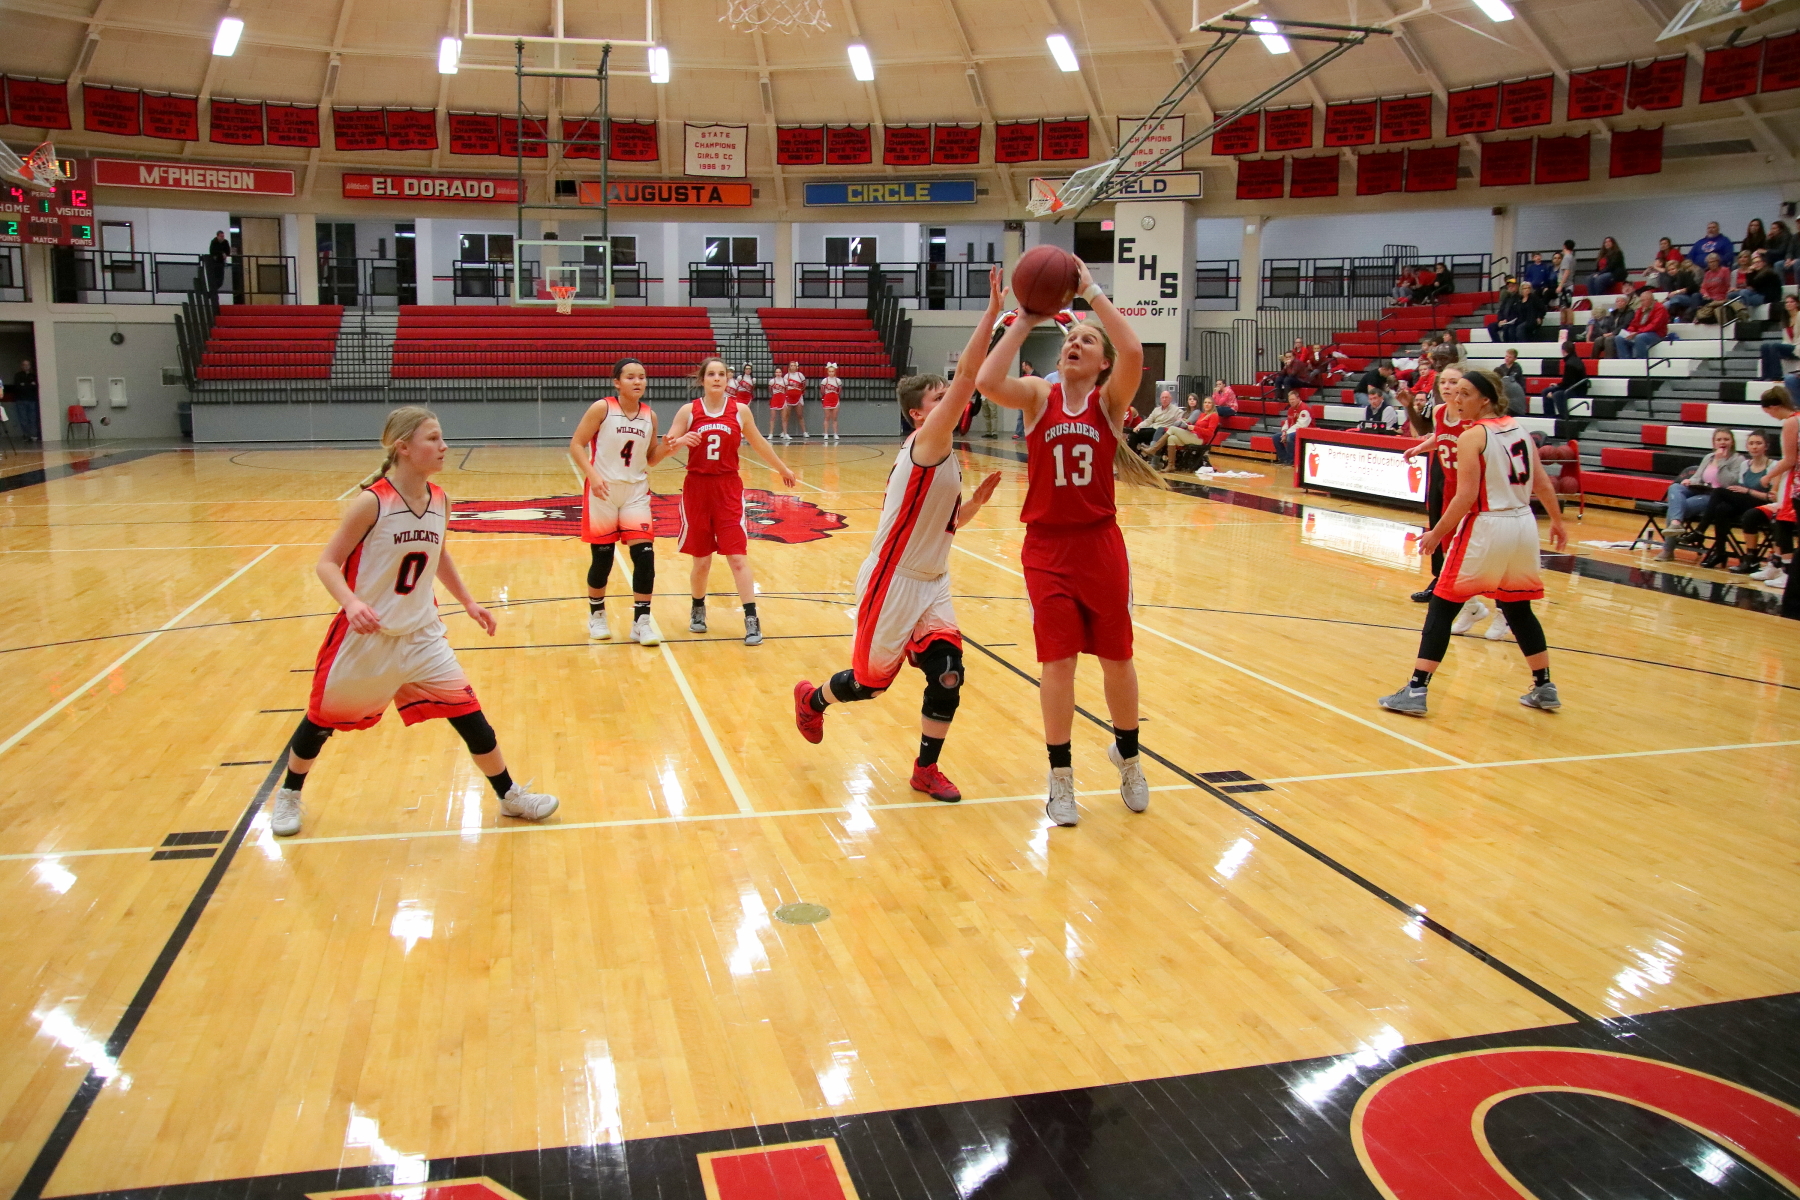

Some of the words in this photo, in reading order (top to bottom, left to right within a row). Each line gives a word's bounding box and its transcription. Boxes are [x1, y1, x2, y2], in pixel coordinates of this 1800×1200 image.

[1130, 135, 1172, 143] CHMPIONS
[11, 187, 24, 203] 4
[372, 177, 399, 195] EL
[403, 179, 495, 198] DORADO
[608, 184, 723, 203] AUGUSTA
[847, 183, 931, 202] CIRCLE
[71, 189, 87, 207] 12
[56, 207, 92, 217] VISITOR
[8, 221, 18, 235] 2
[81, 225, 91, 239] 3
[33, 236, 58, 244] MATCH
[1151, 307, 1164, 316] OF
[1167, 307, 1178, 316] IT
[616, 426, 645, 439] WILDCATS
[697, 423, 732, 435] CRUSADERS
[1045, 422, 1100, 443] CRUSADERS
[620, 440, 635, 467] 4
[707, 434, 721, 461] 2
[1053, 444, 1093, 487] 13
[1328, 448, 1357, 461] Partners
[1367, 453, 1406, 467] Education
[393, 530, 439, 545] WILDCATS
[394, 551, 429, 596] 0
